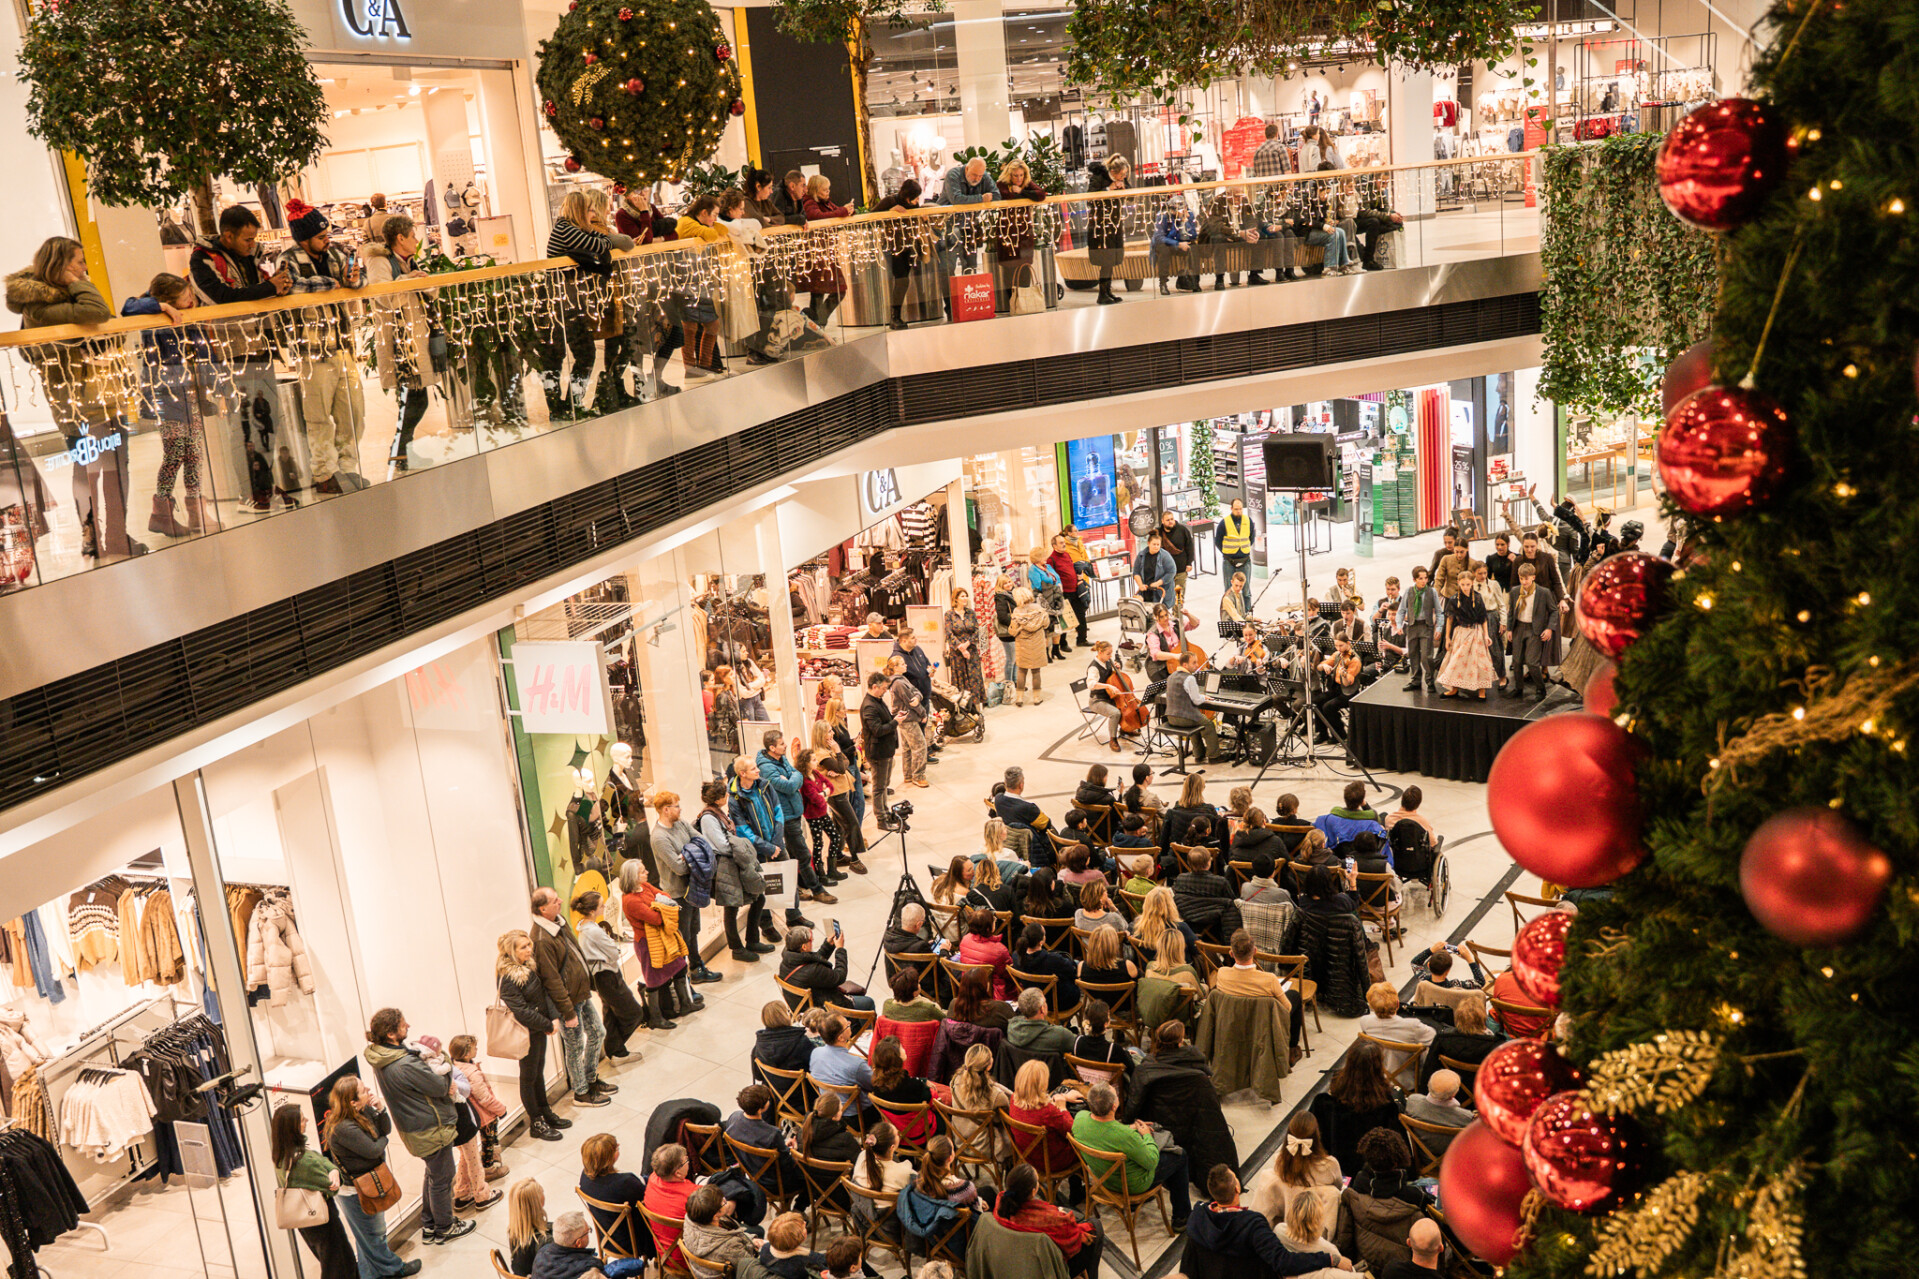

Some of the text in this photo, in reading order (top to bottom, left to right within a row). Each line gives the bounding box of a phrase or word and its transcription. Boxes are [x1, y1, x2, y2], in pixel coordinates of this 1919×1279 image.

[342, 0, 411, 38] C&A
[866, 467, 902, 513] C&A
[1130, 513, 1154, 526] -25%
[524, 664, 591, 716] H&M
